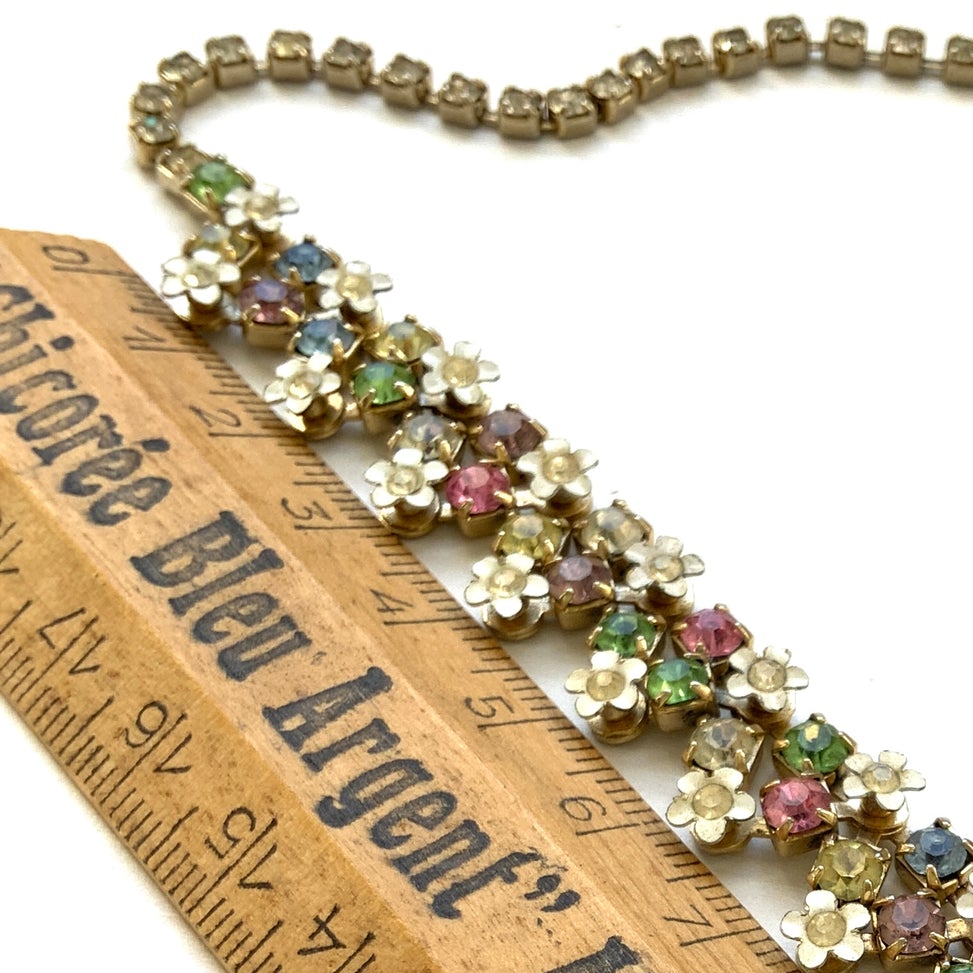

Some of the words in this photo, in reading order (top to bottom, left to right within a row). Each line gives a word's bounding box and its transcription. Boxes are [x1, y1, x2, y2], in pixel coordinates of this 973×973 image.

[38, 606, 107, 676] 17
[42, 245, 90, 265] 0
[122, 325, 166, 343] 1
[189, 404, 242, 430] 2
[280, 497, 334, 522] 3
[369, 588, 414, 614] 4
[464, 695, 510, 720] 5
[558, 795, 608, 823] 6
[663, 904, 714, 930] 7
[129, 510, 313, 683] Bleu
[203, 805, 280, 891] 15
